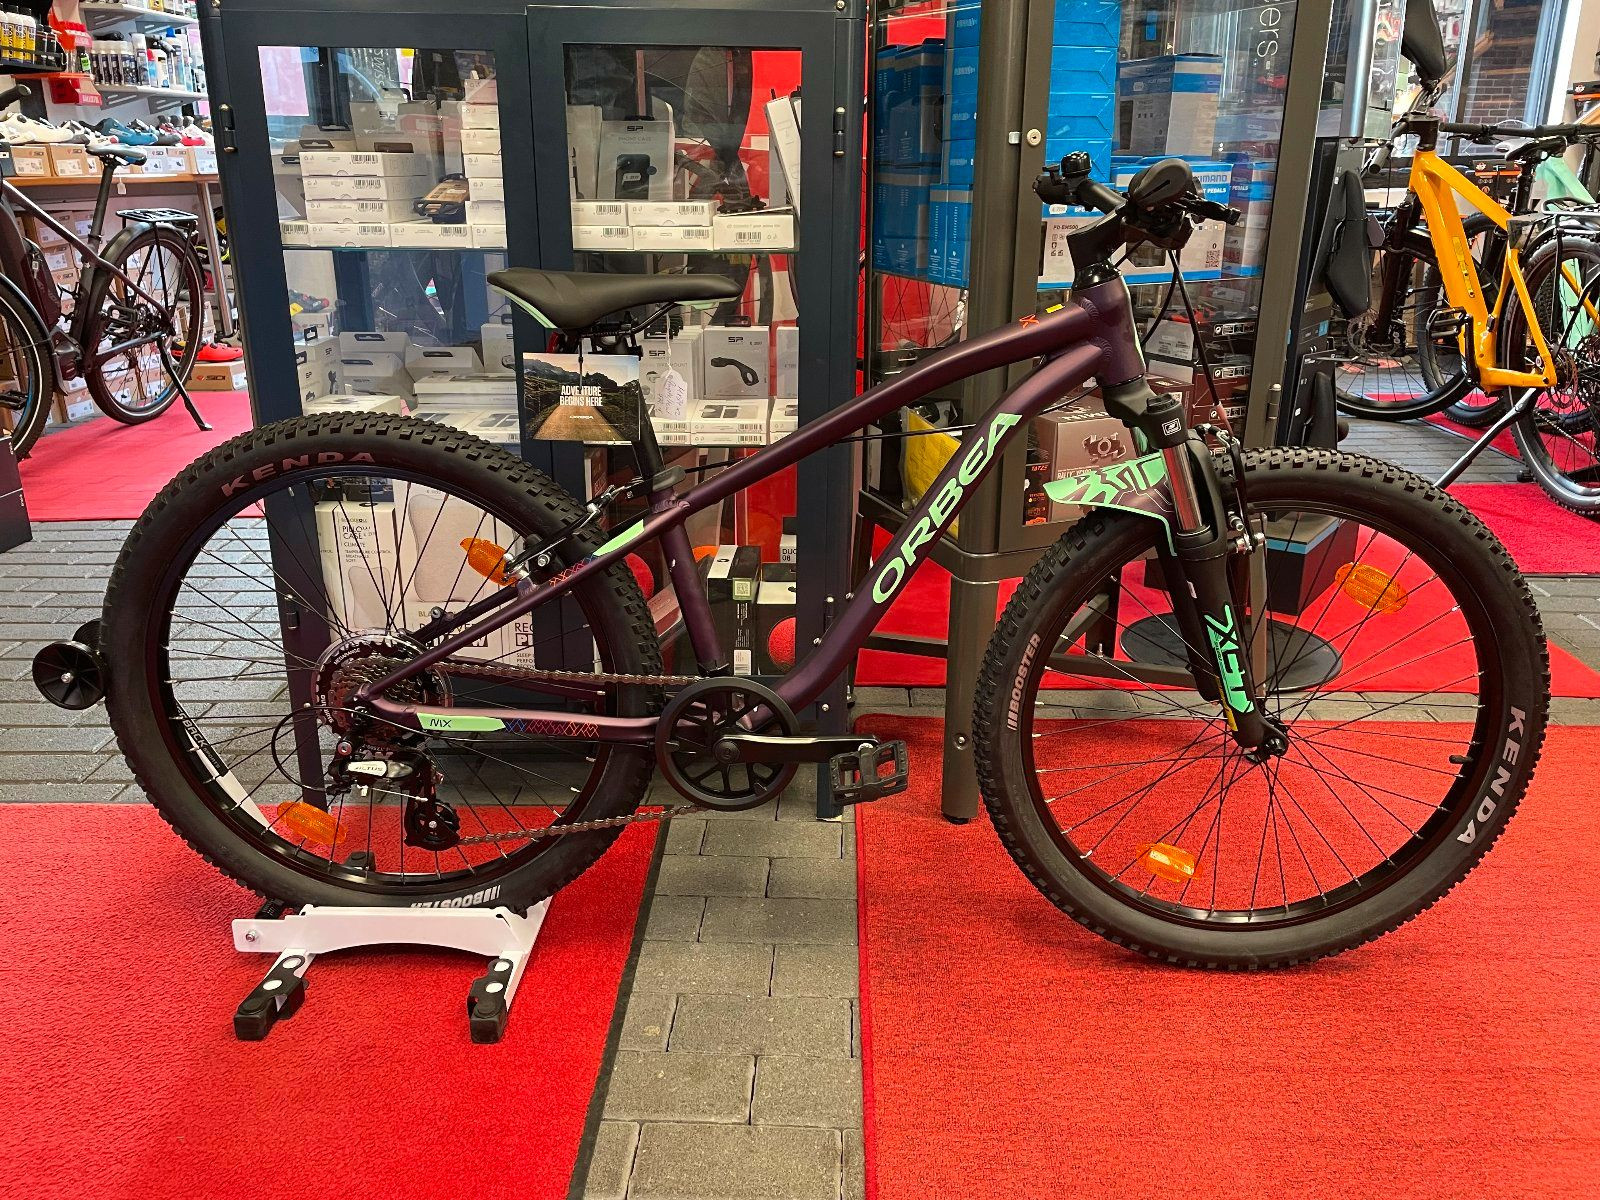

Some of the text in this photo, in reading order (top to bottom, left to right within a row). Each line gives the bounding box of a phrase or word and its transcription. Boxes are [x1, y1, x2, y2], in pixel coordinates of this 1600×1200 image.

[1257, 0, 1281, 57] ers
[1200, 174, 1228, 183] IMANO
[585, 396, 604, 407] HERE
[220, 451, 376, 498] KENDA
[872, 412, 1023, 604] ORBEA
[781, 554, 791, 562] 08
[1009, 632, 1041, 710] BOOSTER
[1456, 705, 1527, 844] KENDA
